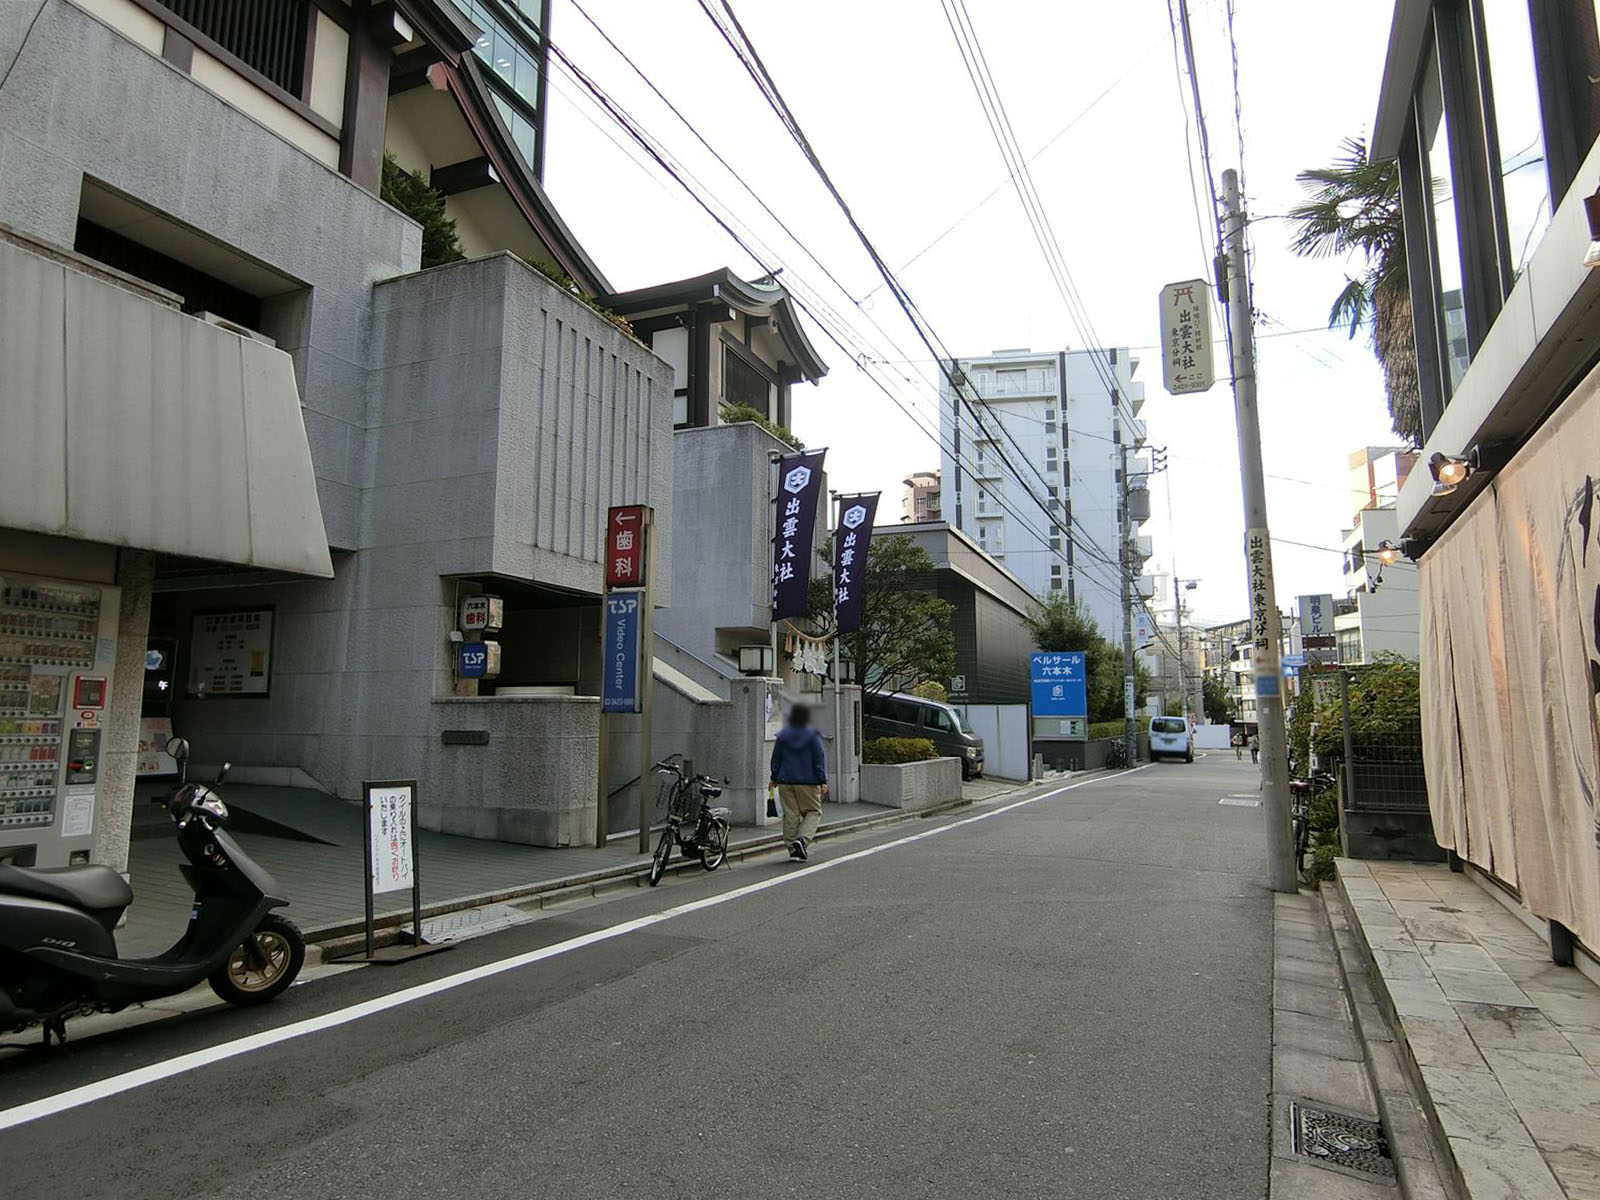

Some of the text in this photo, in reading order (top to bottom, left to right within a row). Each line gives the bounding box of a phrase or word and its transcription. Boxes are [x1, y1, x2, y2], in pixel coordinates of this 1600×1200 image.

[1171, 327, 1181, 367] 東京分祠
[1180, 309, 1196, 370] 出雲大社
[1189, 372, 1203, 380] ここ
[615, 530, 634, 578] 歯科
[779, 498, 800, 582] 出雲大社
[838, 532, 856, 603] 出雲大社
[608, 600, 637, 614] TSP
[1250, 536, 1269, 650] 出雲大社東京分祠
[465, 611, 486, 625] 歯科
[463, 652, 485, 665] TSP
[615, 618, 626, 690] Video Center
[1033, 655, 1081, 665] ベルサール
[1042, 666, 1072, 676] 六本木
[380, 796, 389, 836] いたします
